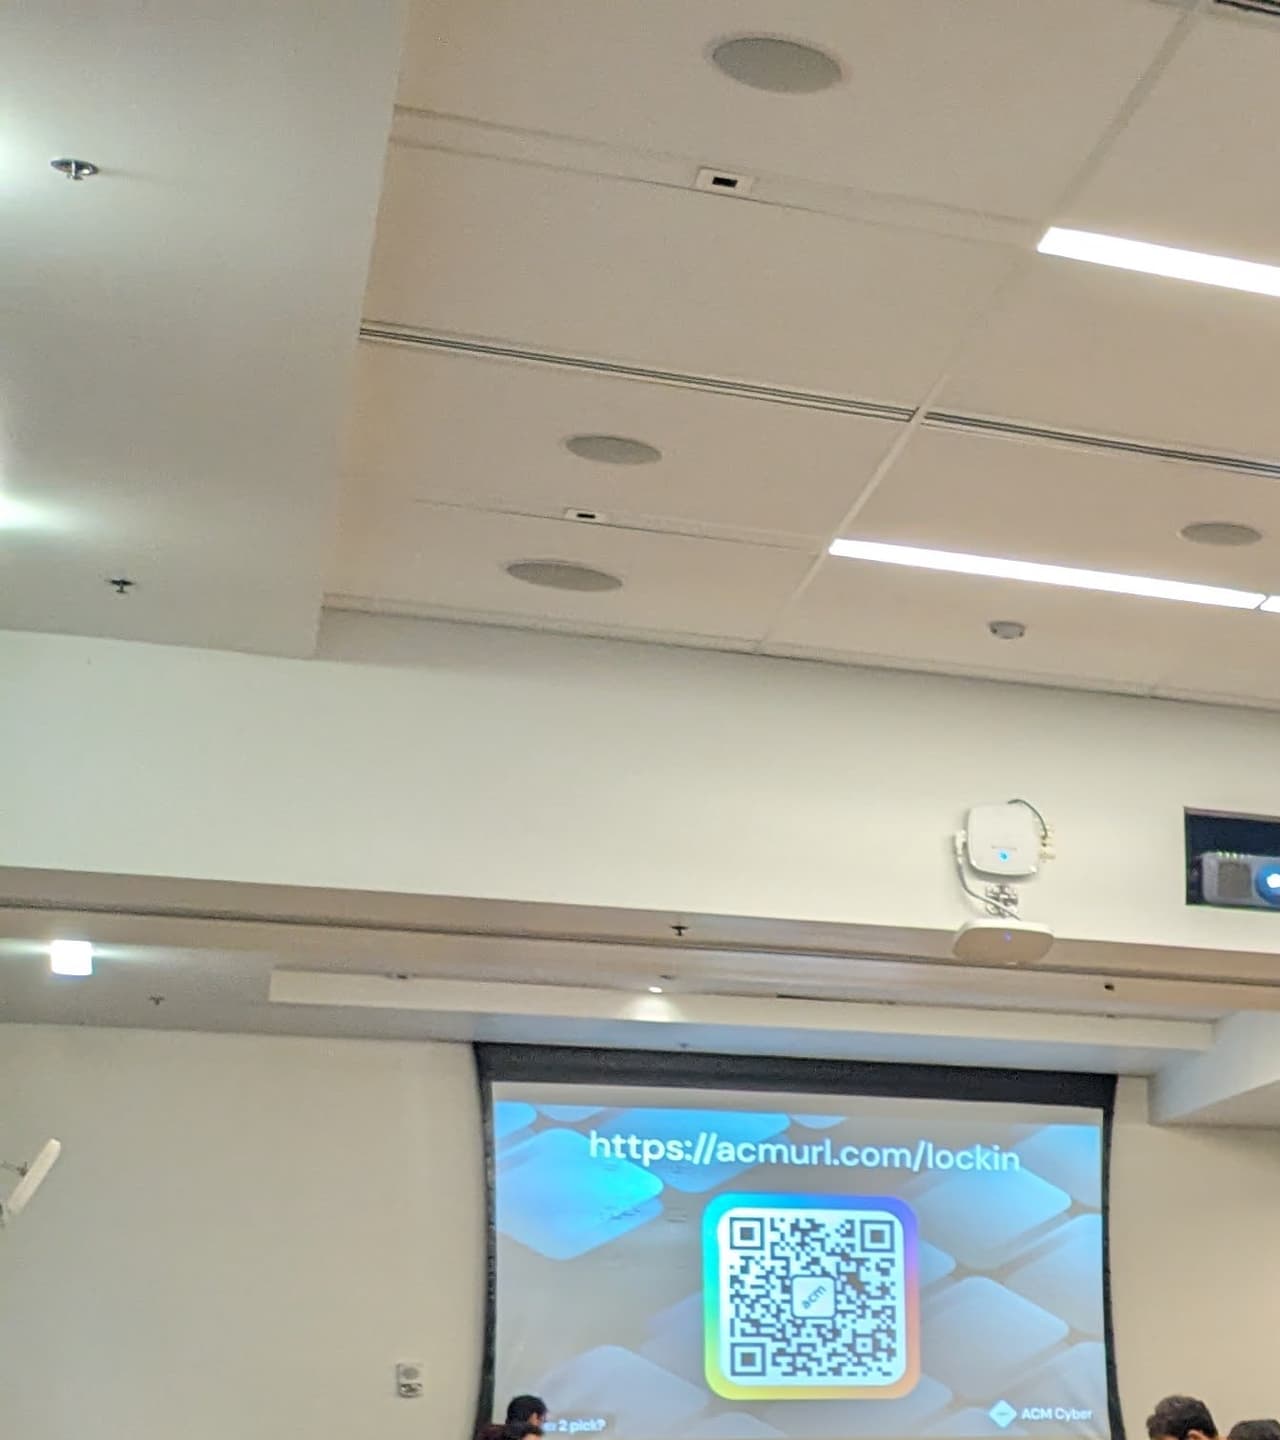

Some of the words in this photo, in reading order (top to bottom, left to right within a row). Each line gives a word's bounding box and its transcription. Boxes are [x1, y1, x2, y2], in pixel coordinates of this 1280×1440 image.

[589, 1130, 1020, 1172] https://acmurl.com/lockin
[802, 1286, 827, 1309] acm
[1021, 1407, 1053, 1420] ACM
[1054, 1408, 1092, 1422] Cyber
